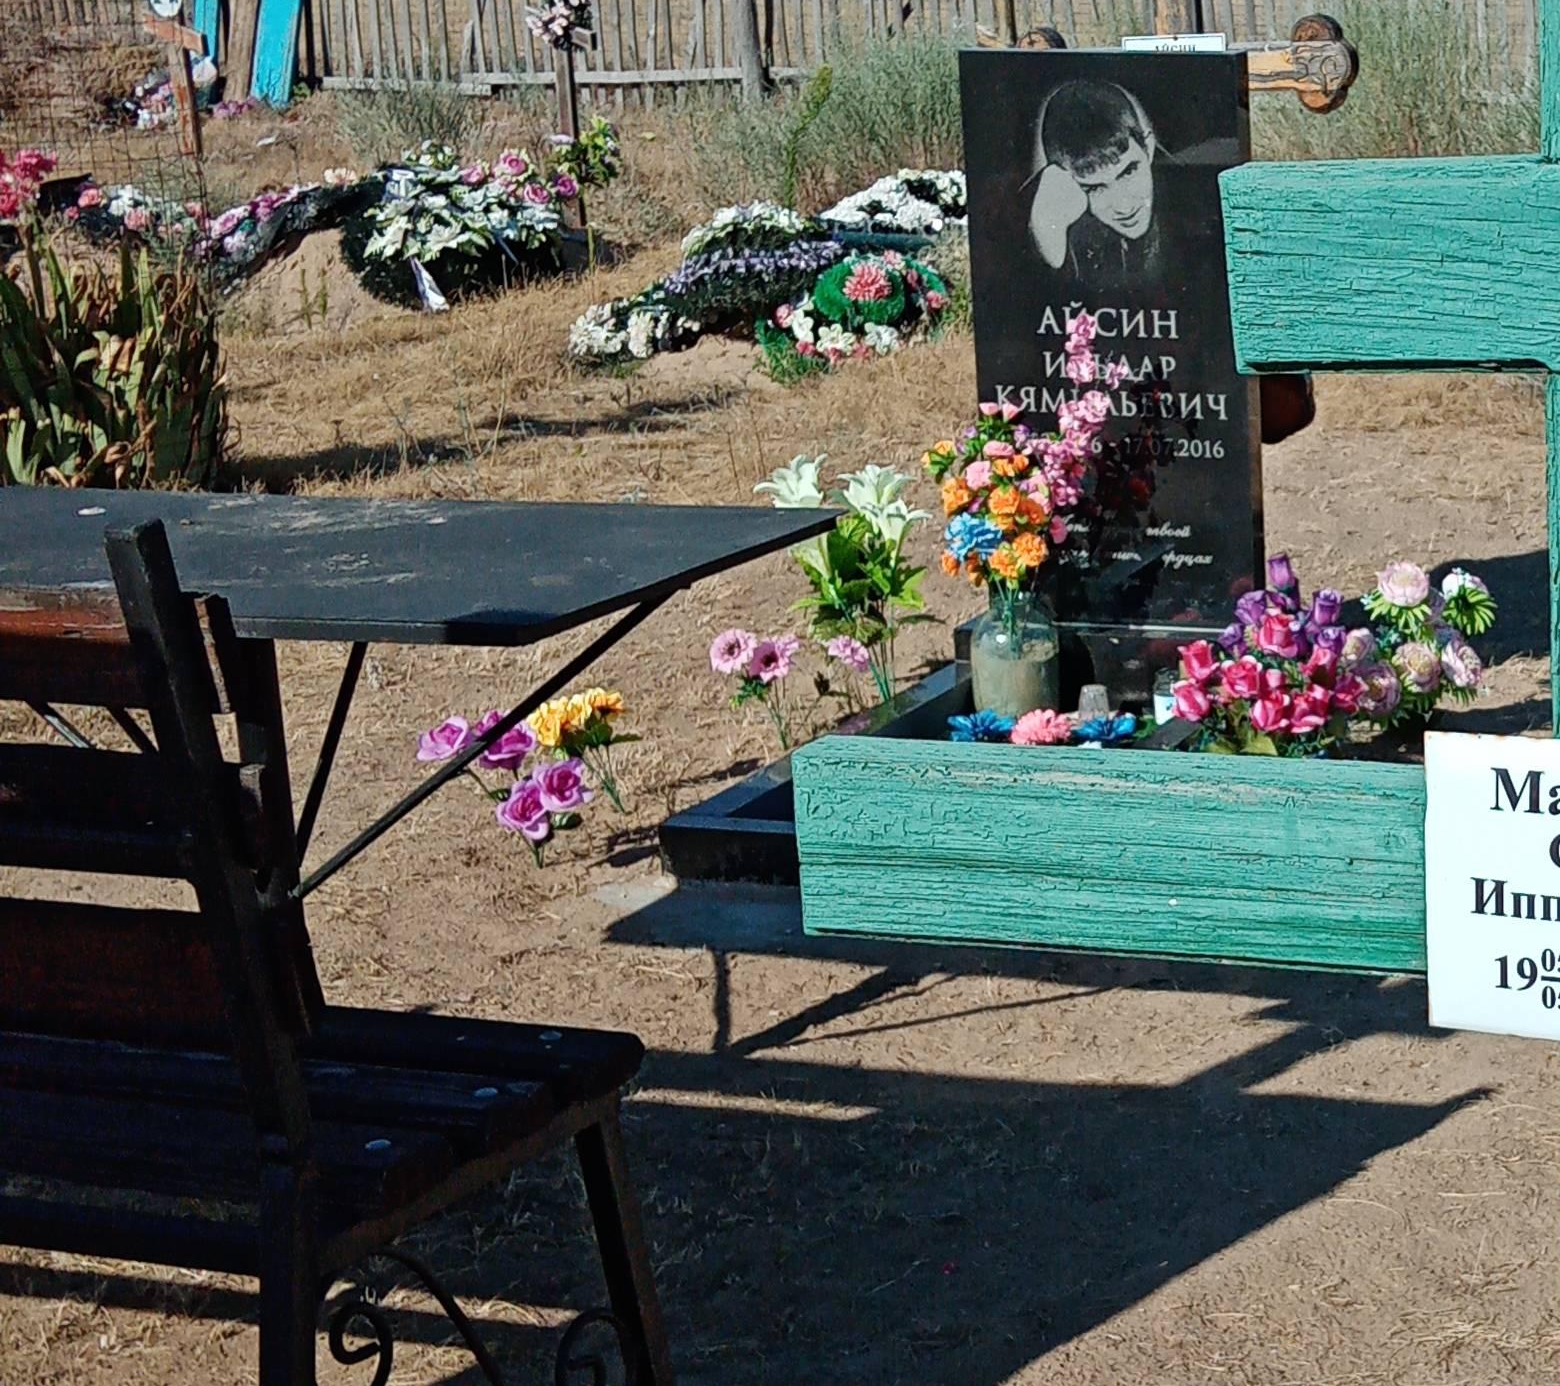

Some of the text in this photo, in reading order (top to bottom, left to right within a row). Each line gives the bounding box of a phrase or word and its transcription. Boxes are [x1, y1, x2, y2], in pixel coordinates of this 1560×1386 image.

[1042, 351, 1177, 382] ИЬДАР
[995, 384, 1229, 421] КЯМЬЕВИЧ
[1161, 550, 1214, 570] рдцах
